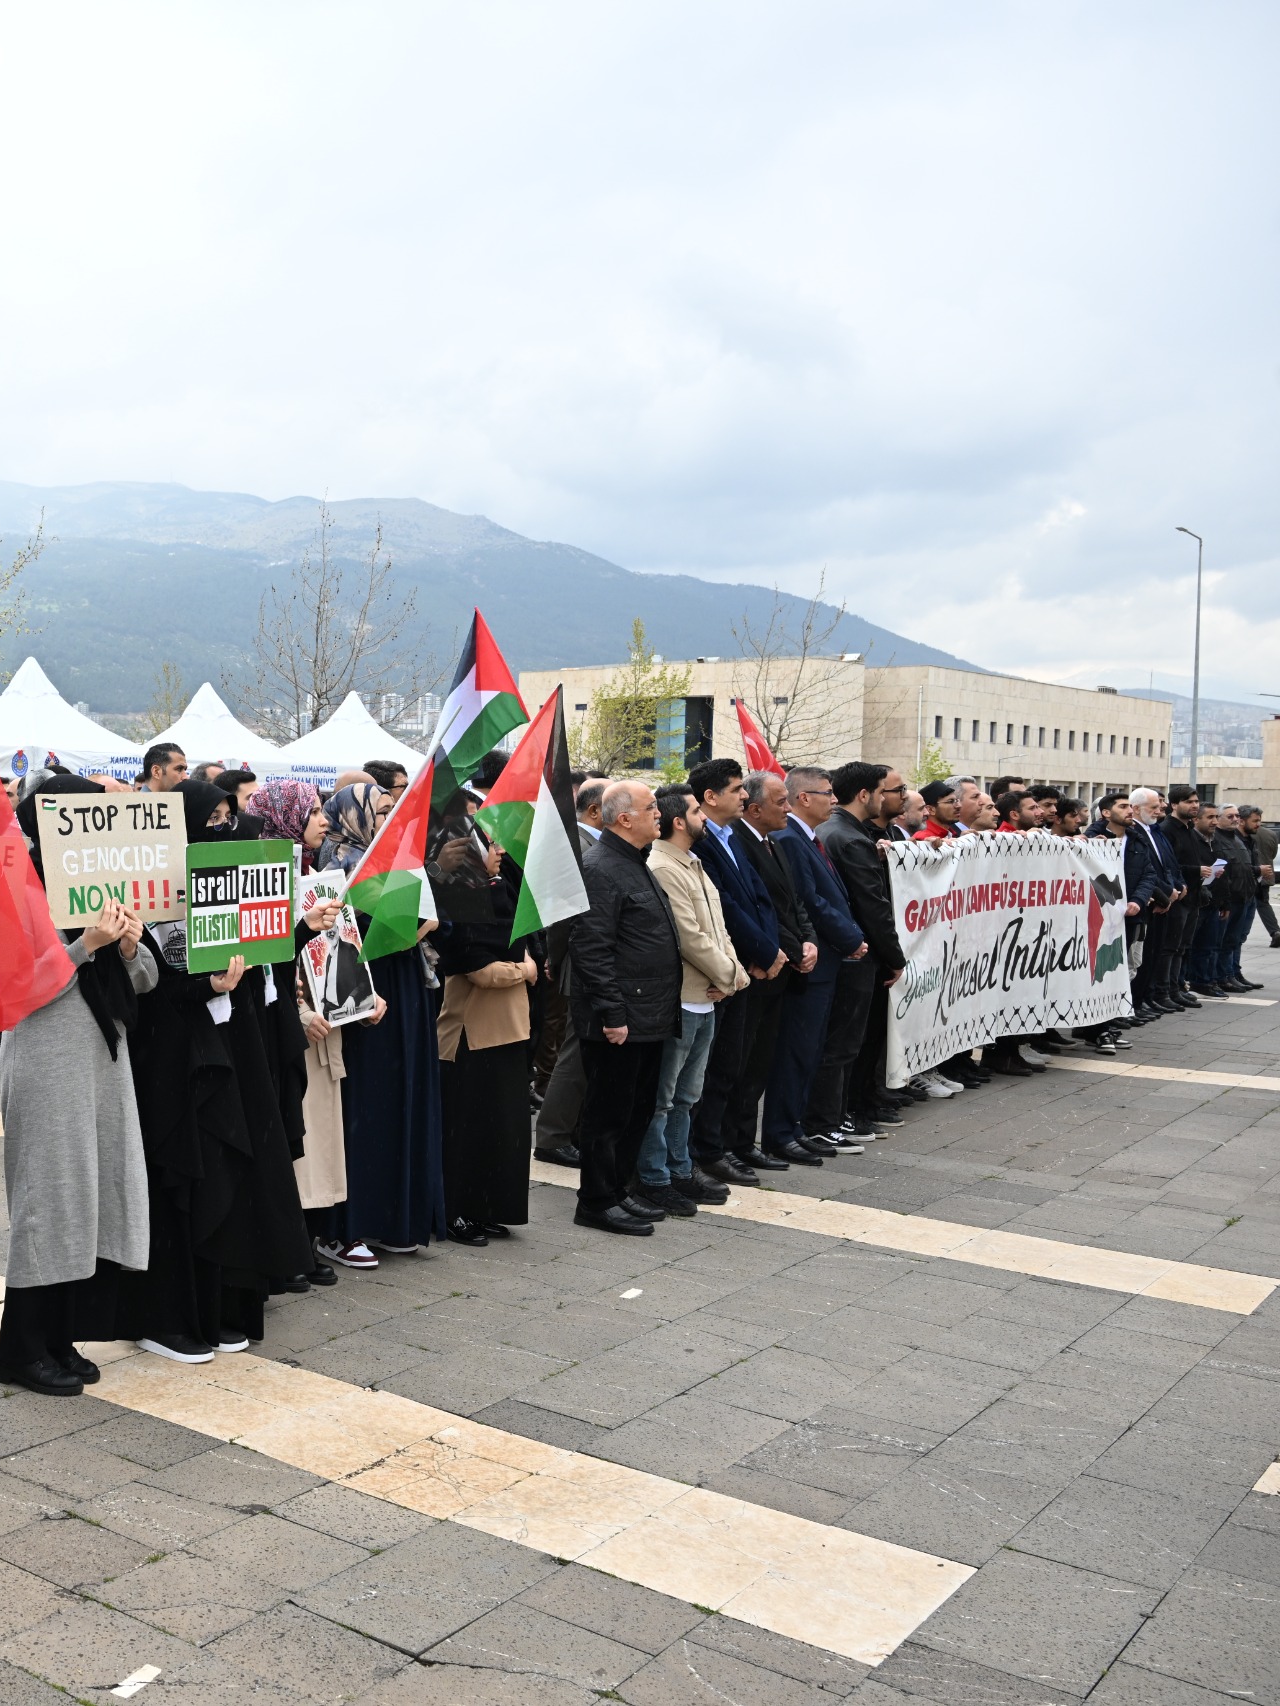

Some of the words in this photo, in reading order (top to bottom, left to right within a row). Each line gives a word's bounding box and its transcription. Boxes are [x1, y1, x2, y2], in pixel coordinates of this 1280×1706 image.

[58, 805, 119, 836] STOP
[126, 803, 171, 831] THE
[62, 844, 169, 876] GENOCIDE
[68, 881, 126, 915] NOW
[966, 873, 1047, 916] KAMPÜSLER
[1049, 872, 1085, 906] AYAĞA
[241, 906, 288, 938] DEVLET
